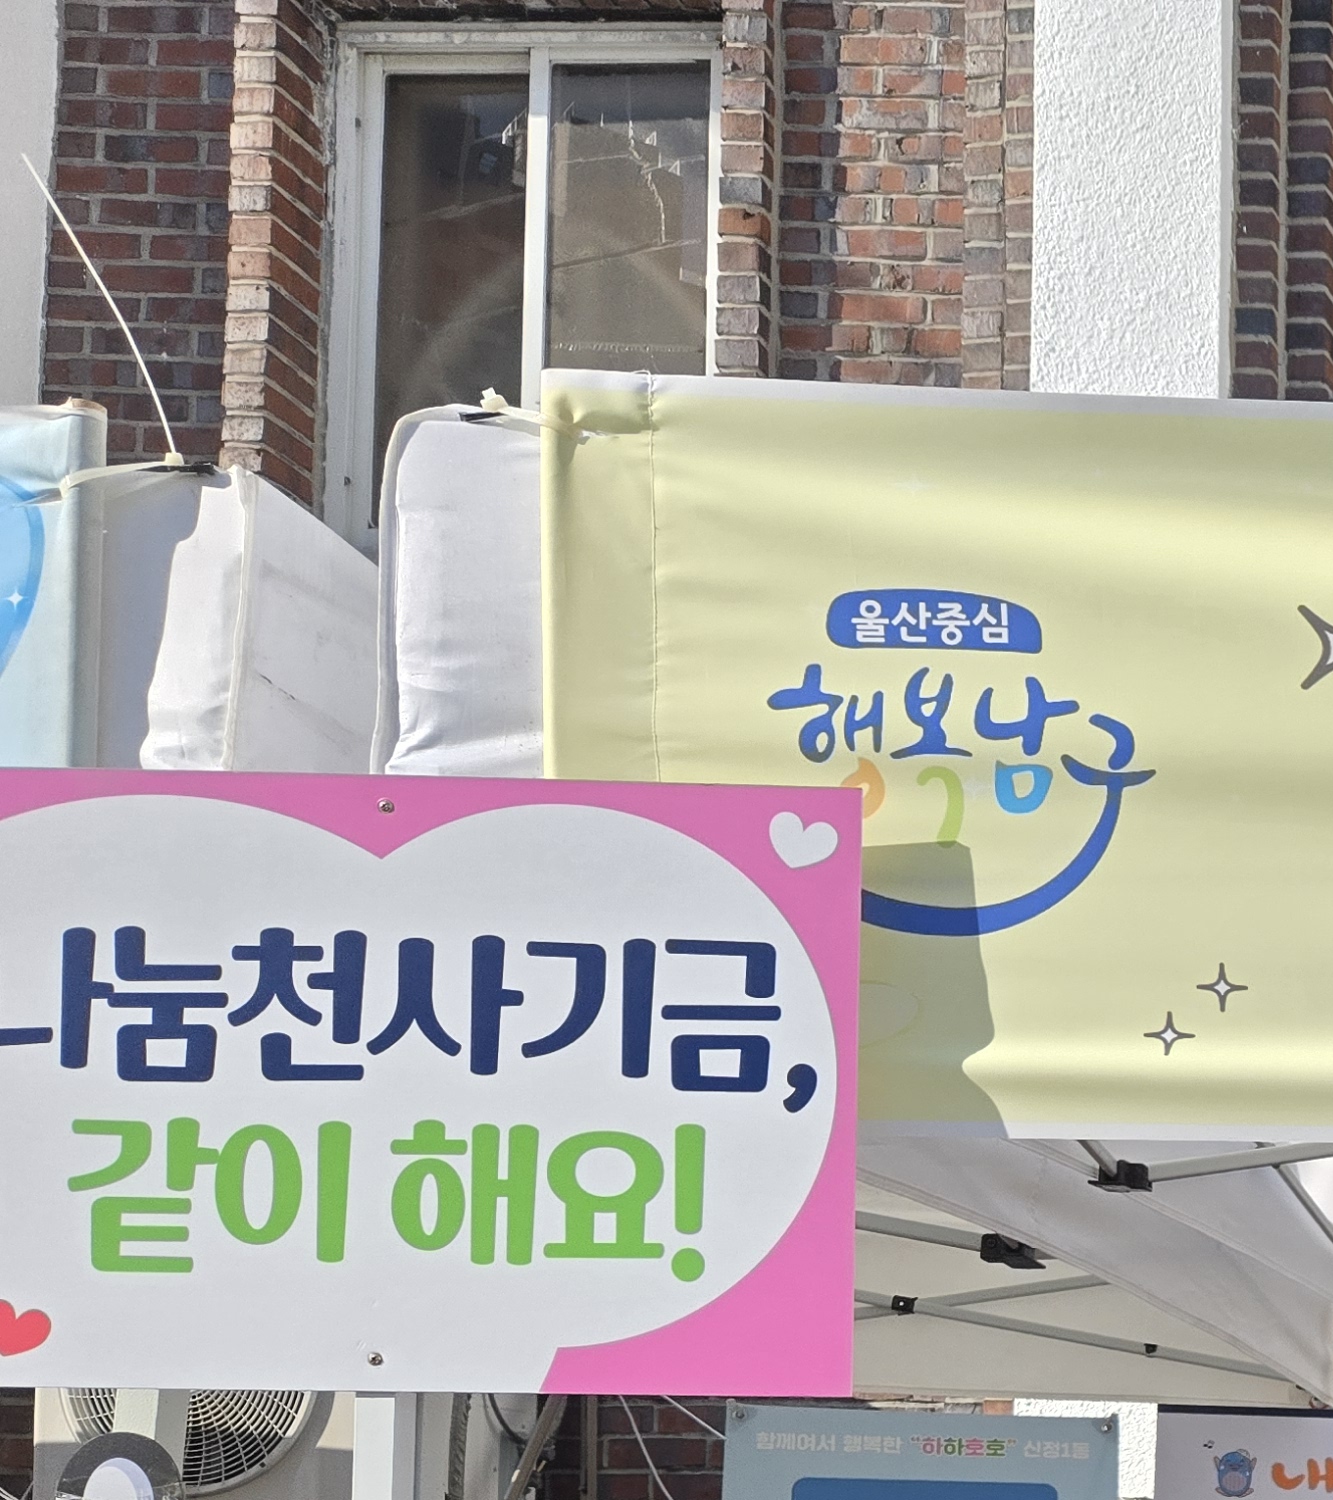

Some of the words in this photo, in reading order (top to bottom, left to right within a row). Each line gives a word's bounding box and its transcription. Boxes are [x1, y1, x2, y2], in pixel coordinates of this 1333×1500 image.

[850, 599, 1010, 645] 울산중심
[0, 926, 818, 1113] 나눔천사기금,
[67, 1117, 352, 1273] 같이
[390, 1118, 706, 1283] 해요!
[1023, 1440, 1091, 1460] 신정1동
